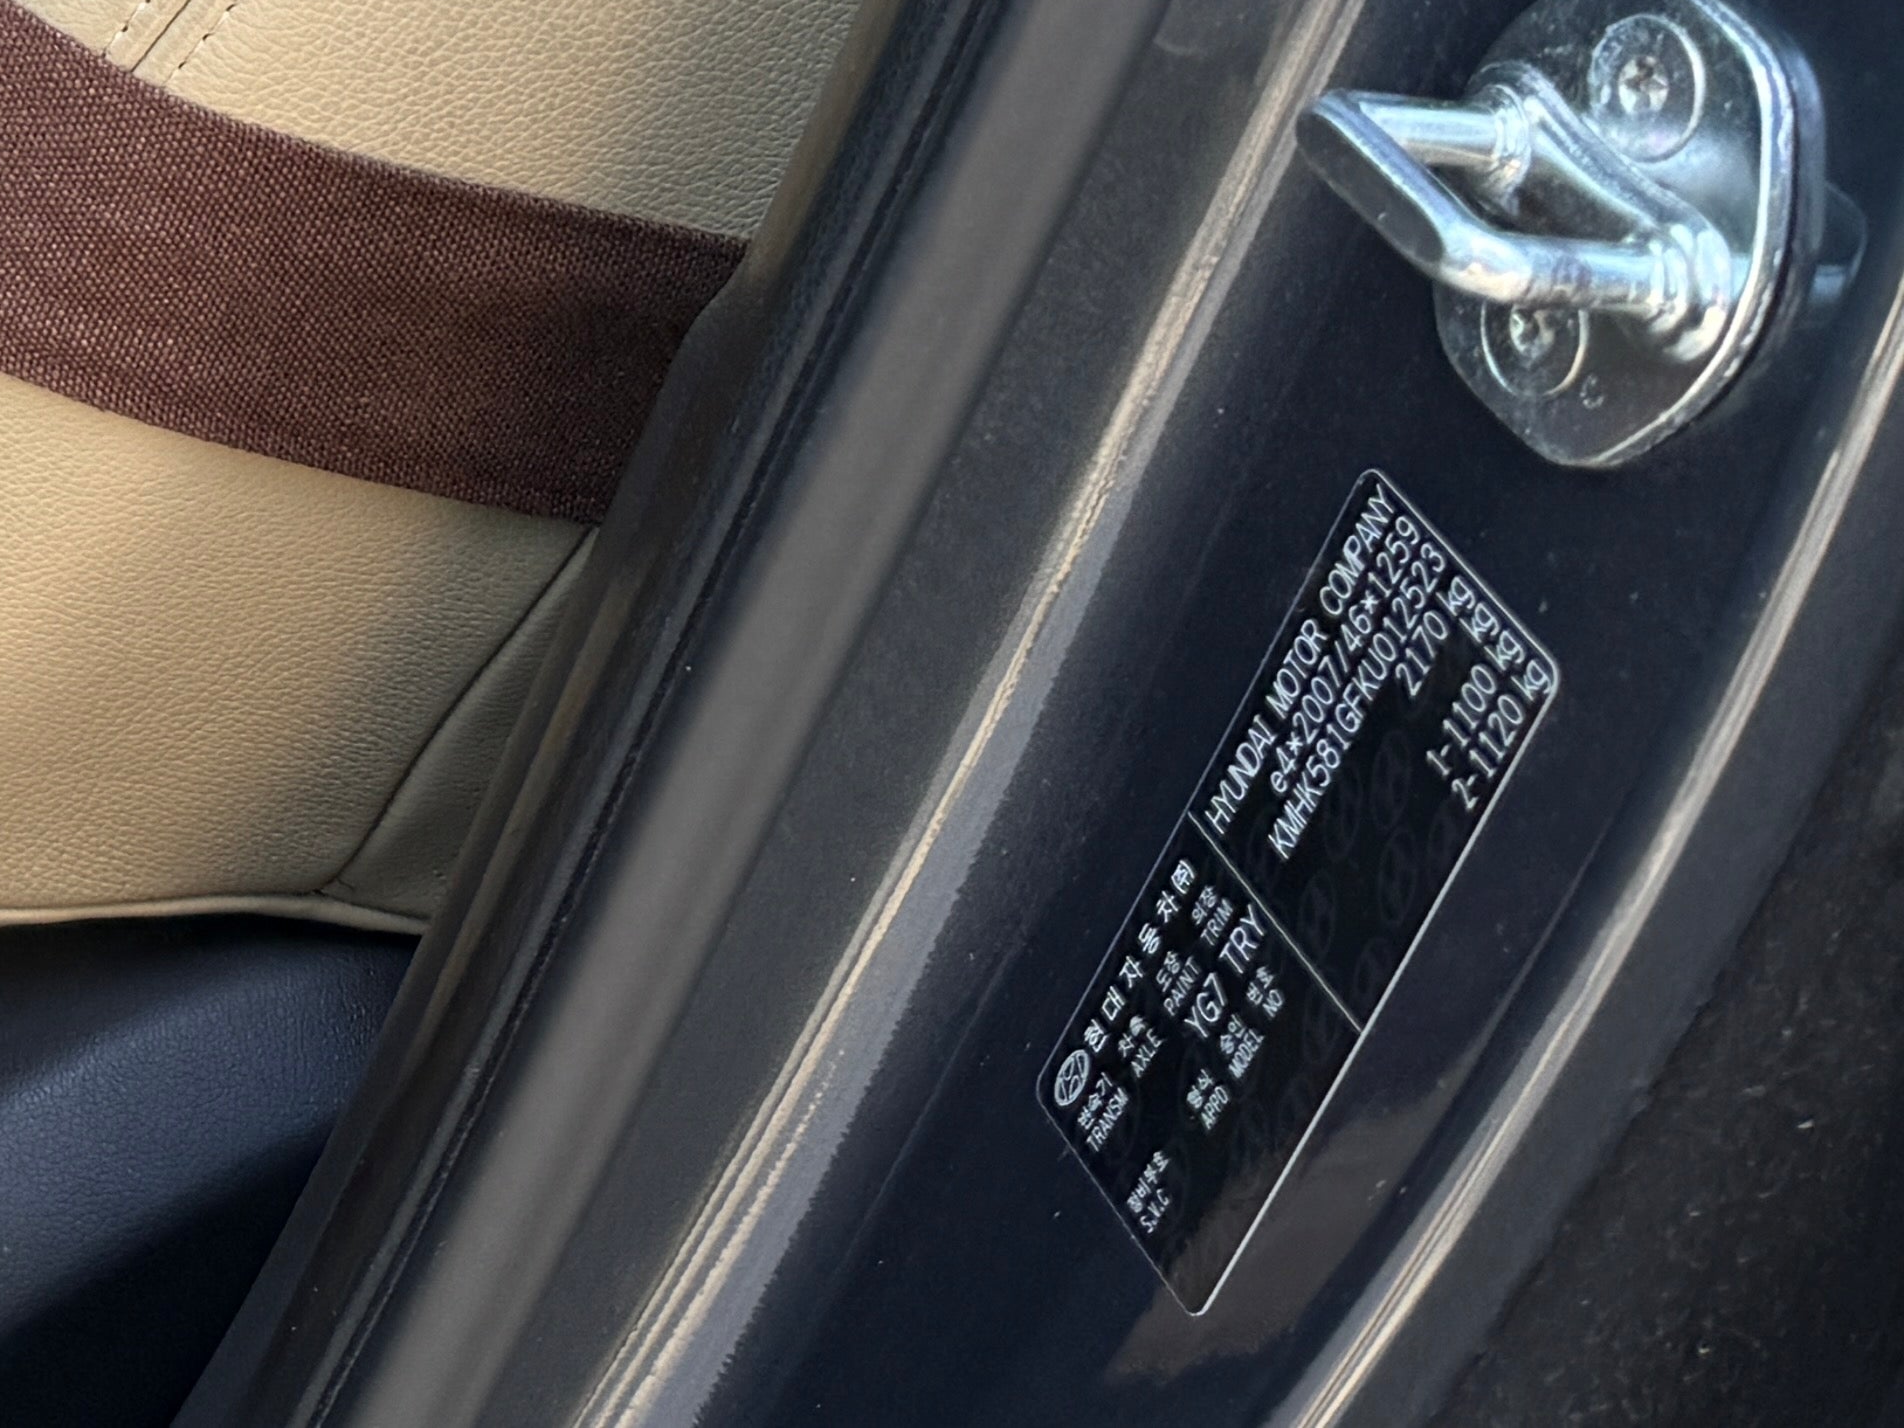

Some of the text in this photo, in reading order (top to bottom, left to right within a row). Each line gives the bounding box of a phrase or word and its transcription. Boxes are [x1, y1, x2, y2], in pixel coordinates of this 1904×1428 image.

[1204, 483, 1393, 834] HYUNDAI MOTOR COMPANY
[1395, 576, 1476, 696] 2170 kg
[1459, 601, 1499, 646] kg
[1483, 629, 1526, 675] kg
[1510, 658, 1553, 701] kg
[1267, 542, 1445, 858] KMHK581GFKU012523
[1086, 898, 1233, 1151] TRANSM AXLE PAINT TRIM
[1183, 904, 1264, 1037] YG7 TRY
[1228, 1029, 1263, 1078] MODEL
[1262, 989, 1282, 1017] NO
